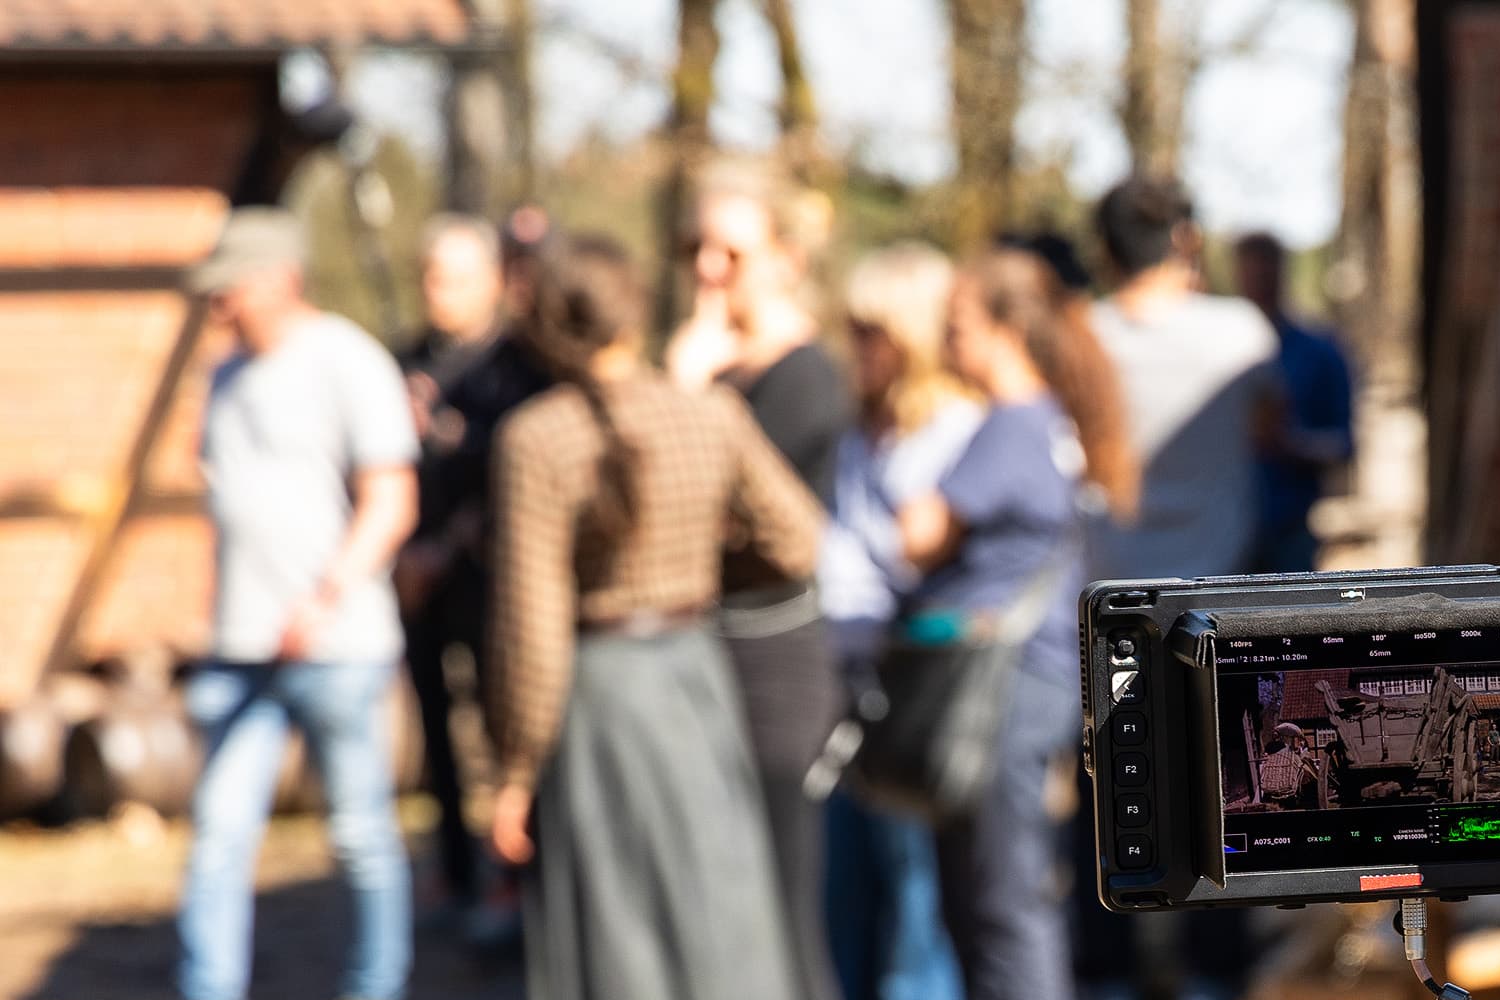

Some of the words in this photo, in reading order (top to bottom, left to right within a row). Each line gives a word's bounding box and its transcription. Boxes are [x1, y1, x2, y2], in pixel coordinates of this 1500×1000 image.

[1123, 724, 1136, 733] F1
[1125, 765, 1137, 774] F2
[1127, 806, 1139, 815] F3
[1128, 847, 1140, 855] F4
